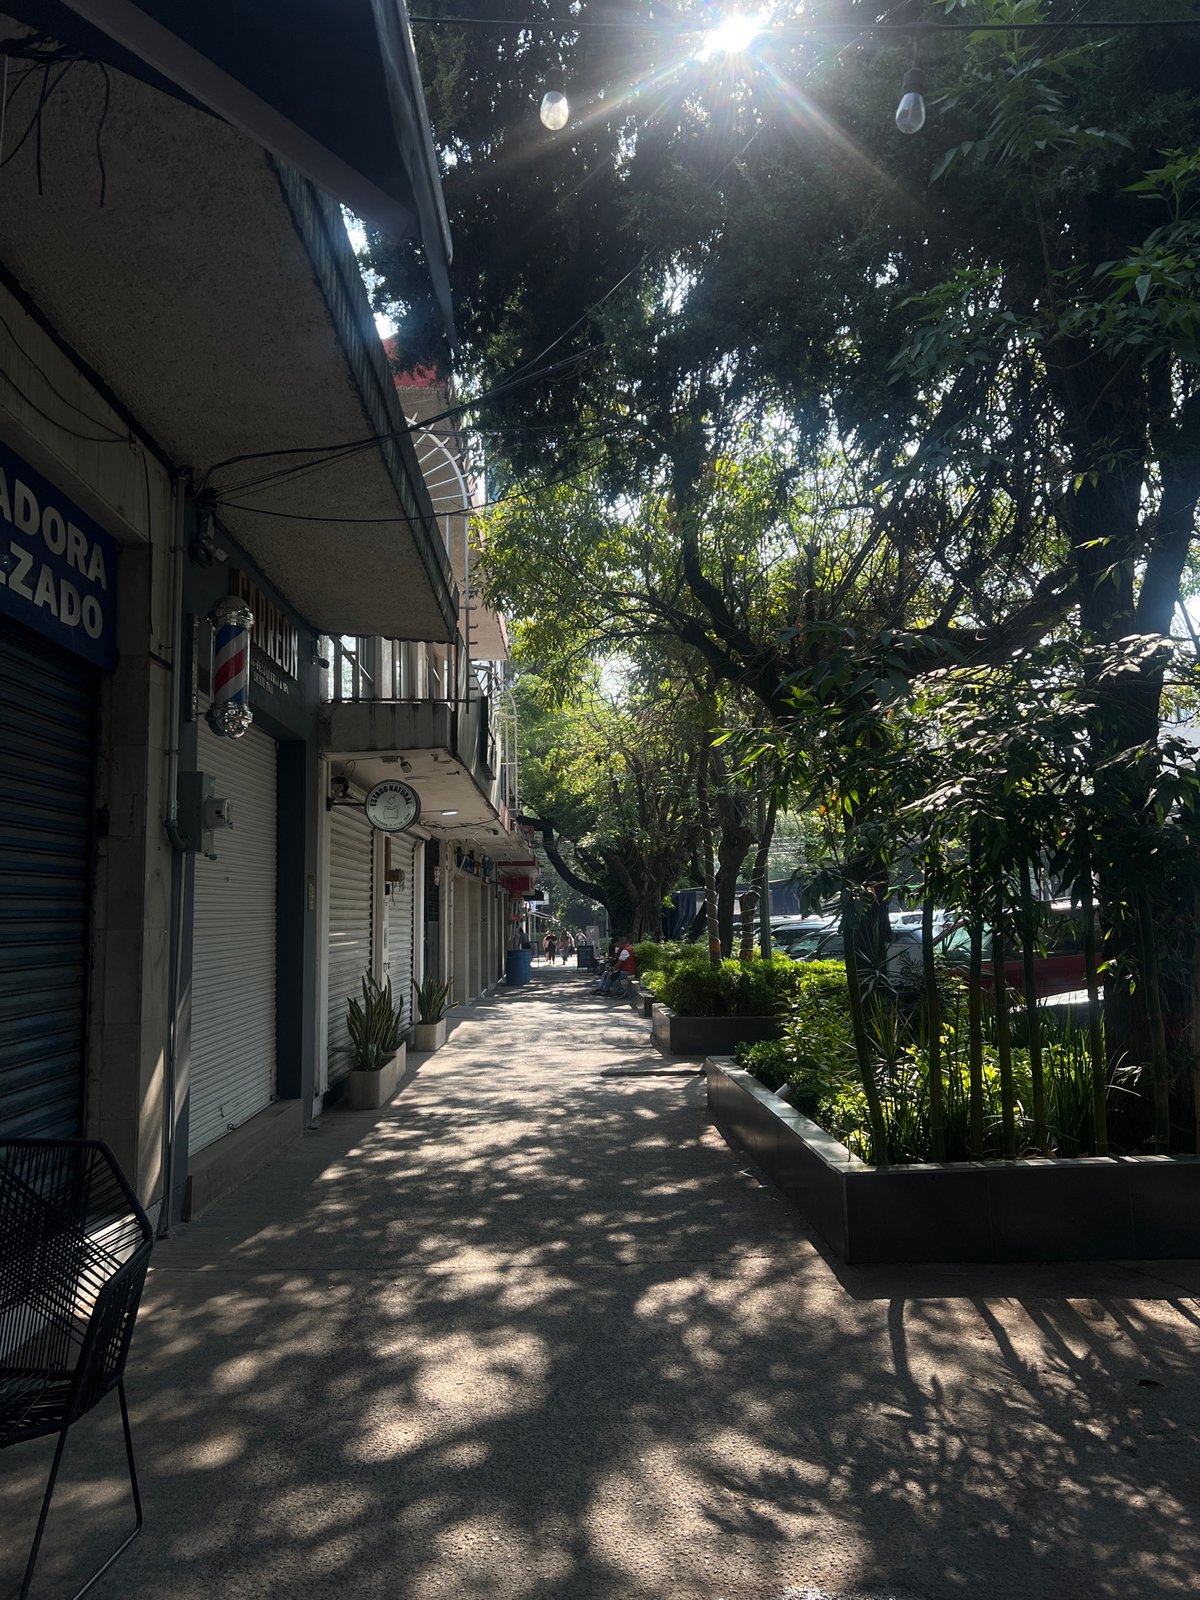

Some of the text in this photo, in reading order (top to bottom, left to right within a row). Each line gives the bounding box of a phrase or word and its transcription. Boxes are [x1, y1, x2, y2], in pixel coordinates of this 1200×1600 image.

[0, 541, 103, 639] ZADO
[369, 785, 412, 807] ESTADO NATURAL
